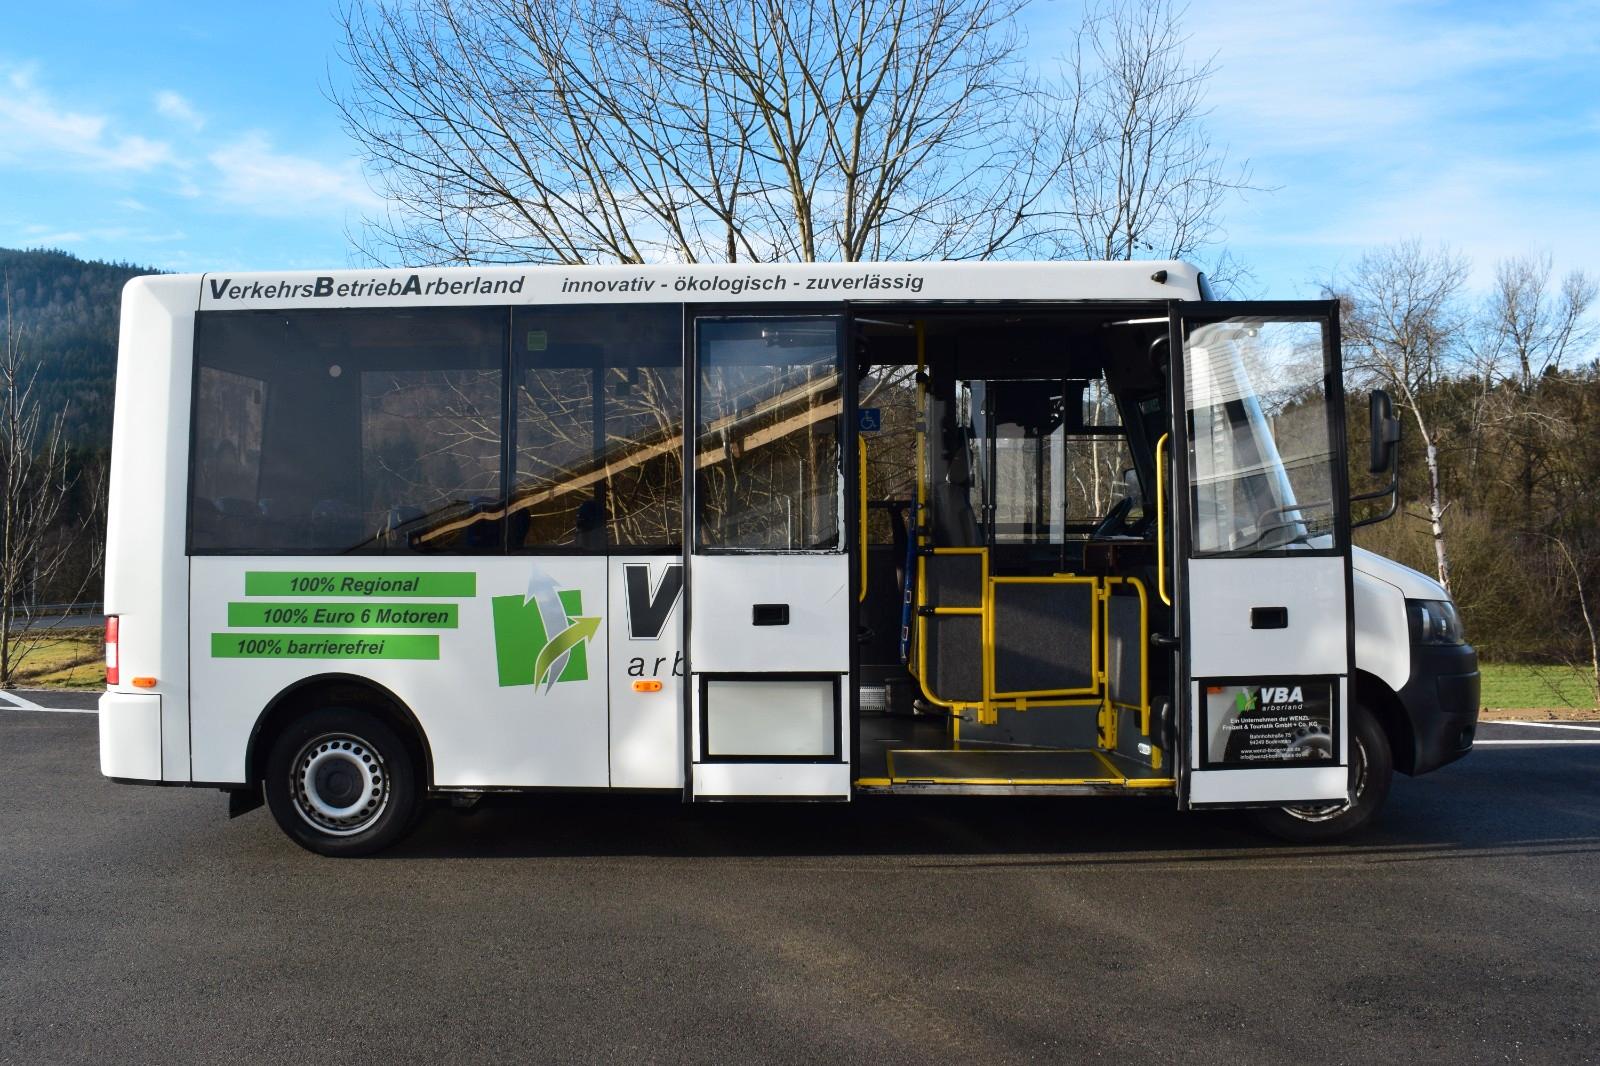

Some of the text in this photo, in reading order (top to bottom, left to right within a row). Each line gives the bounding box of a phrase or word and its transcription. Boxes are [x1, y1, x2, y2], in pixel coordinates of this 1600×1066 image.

[561, 277, 655, 293] innovativ
[673, 275, 787, 295] ökologisch
[805, 273, 924, 293] zuverlässig
[289, 576, 420, 595] 100% Regional
[263, 608, 449, 624] 100% Euro 6 Motoren
[237, 639, 385, 655] 100% barrierefrei
[1260, 686, 1303, 703] VBA
